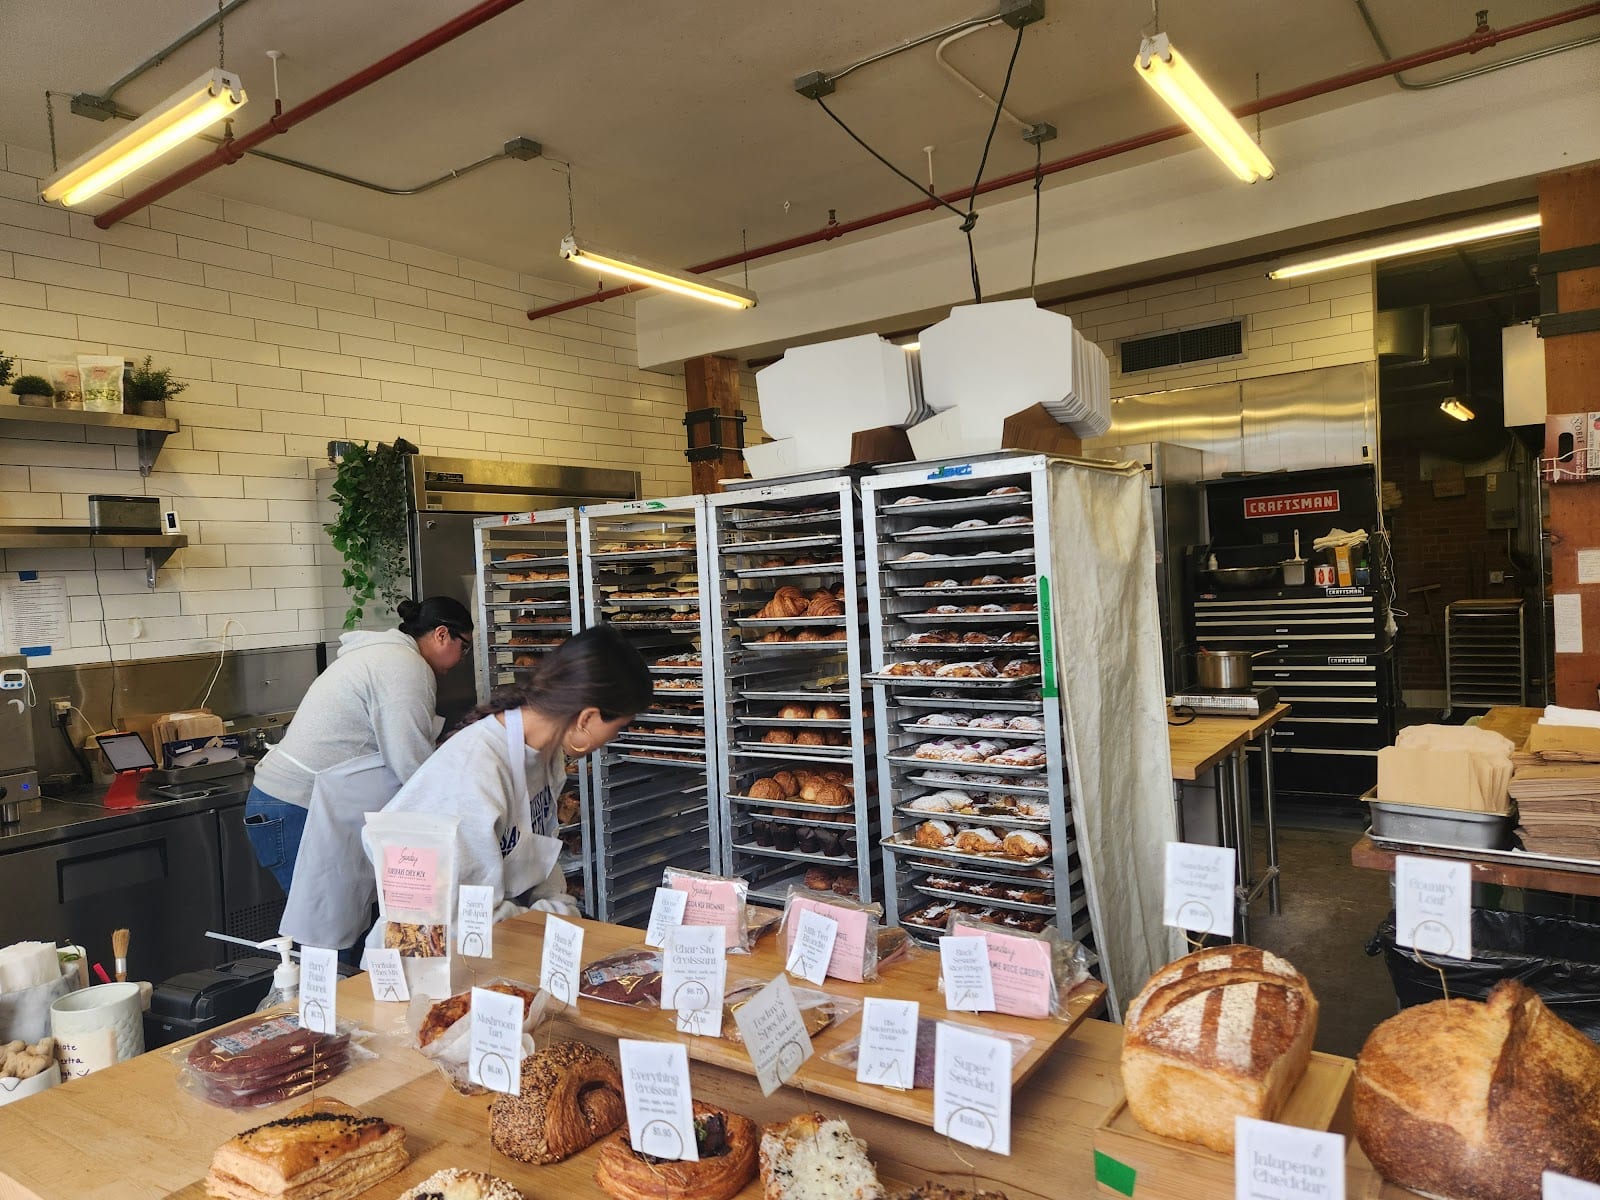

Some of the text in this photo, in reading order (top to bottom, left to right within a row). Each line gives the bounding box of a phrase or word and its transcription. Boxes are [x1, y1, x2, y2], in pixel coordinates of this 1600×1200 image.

[1250, 496, 1333, 514] CRAFTSMAN
[1328, 588, 1363, 596] CRAFTSMAN
[1410, 878, 1455, 898] Country
[1418, 891, 1446, 906] Loaf
[675, 943, 715, 954] Char Siu
[673, 955, 716, 965] Croissant
[477, 1012, 516, 1031] Mushroom
[753, 1000, 785, 1029] Today's
[757, 1009, 788, 1039] Special
[488, 1026, 503, 1039] Tart
[953, 1055, 991, 1076] Super
[630, 1066, 680, 1087] Everything
[949, 1069, 995, 1093] Seeded
[634, 1082, 679, 1098] Croissant
[1253, 1150, 1327, 1178] Jalapeno
[1253, 1168, 1328, 1194] Cheddar
